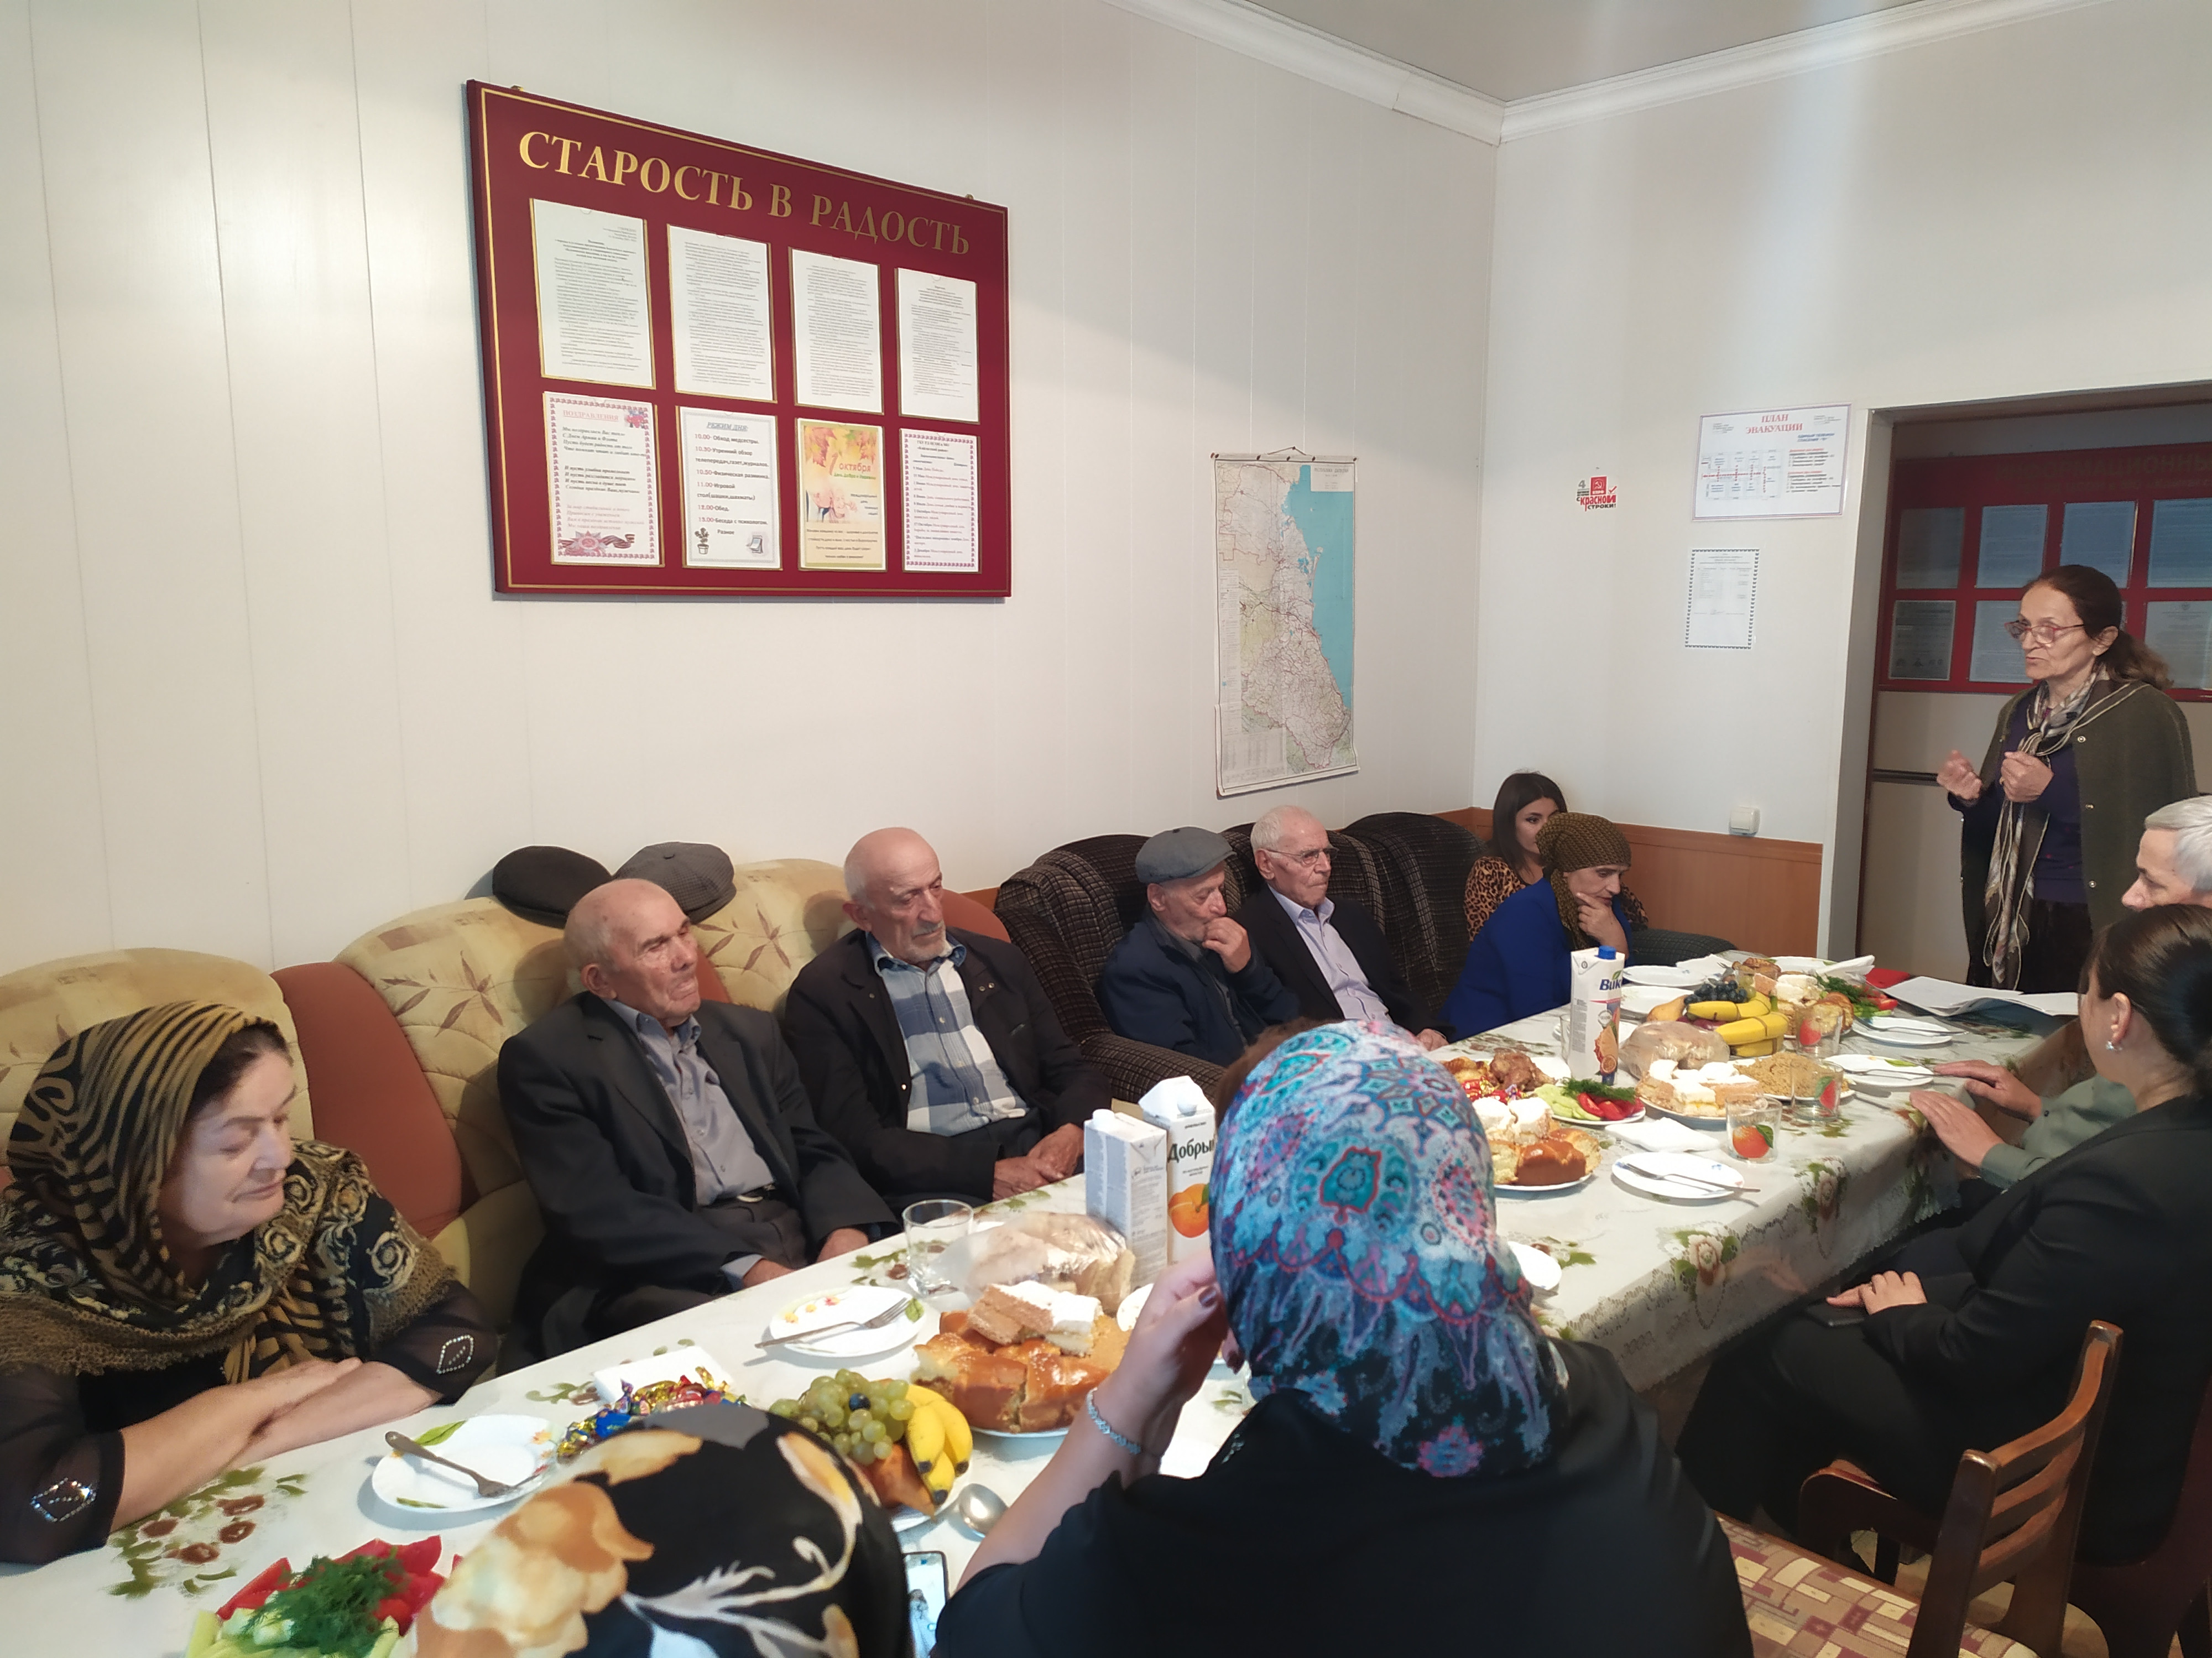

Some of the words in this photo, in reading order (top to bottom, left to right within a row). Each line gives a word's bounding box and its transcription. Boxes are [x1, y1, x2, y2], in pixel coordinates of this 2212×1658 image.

[519, 131, 754, 211] СТАРОСТЬ
[768, 183, 792, 217] В
[811, 194, 970, 255] РАДОСТЬ
[1761, 414, 1789, 423] ПЛАН
[706, 422, 732, 430] РЕЖИМ
[1746, 423, 1803, 434] ЭВАКУАЦИИ
[829, 452, 838, 476] 1
[839, 463, 871, 473] октября
[1578, 480, 1586, 488] 4
